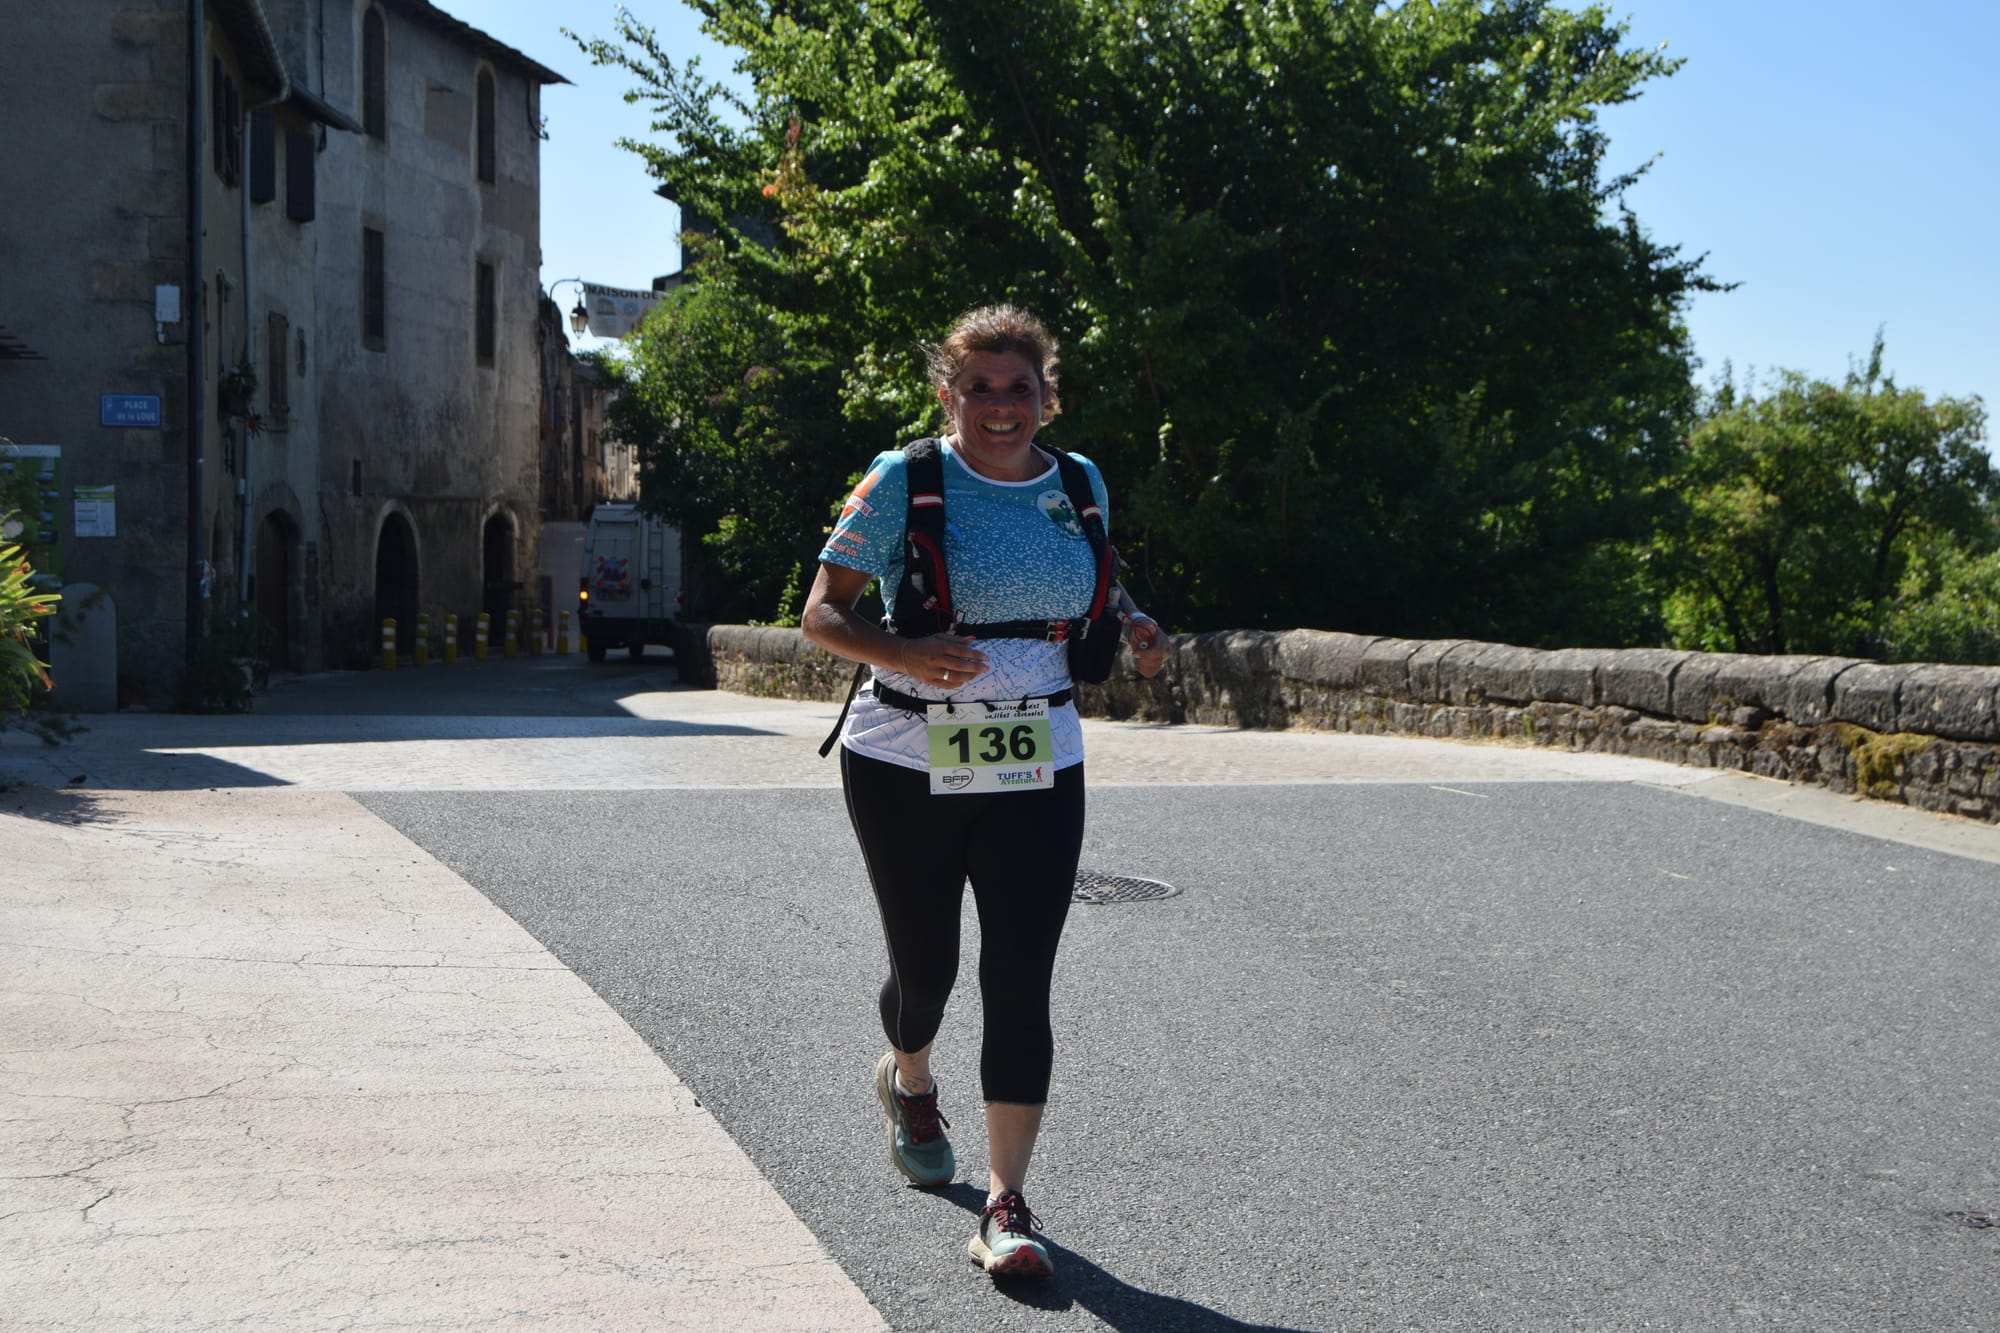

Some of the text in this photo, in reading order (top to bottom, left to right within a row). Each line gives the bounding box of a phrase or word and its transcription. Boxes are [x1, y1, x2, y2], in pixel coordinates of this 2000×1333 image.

[587, 285, 638, 298] MAISON
[124, 400, 148, 409] PLACE
[948, 725, 1036, 764] 136
[942, 775, 970, 783] BFP
[997, 771, 1033, 780] TUFF'S
